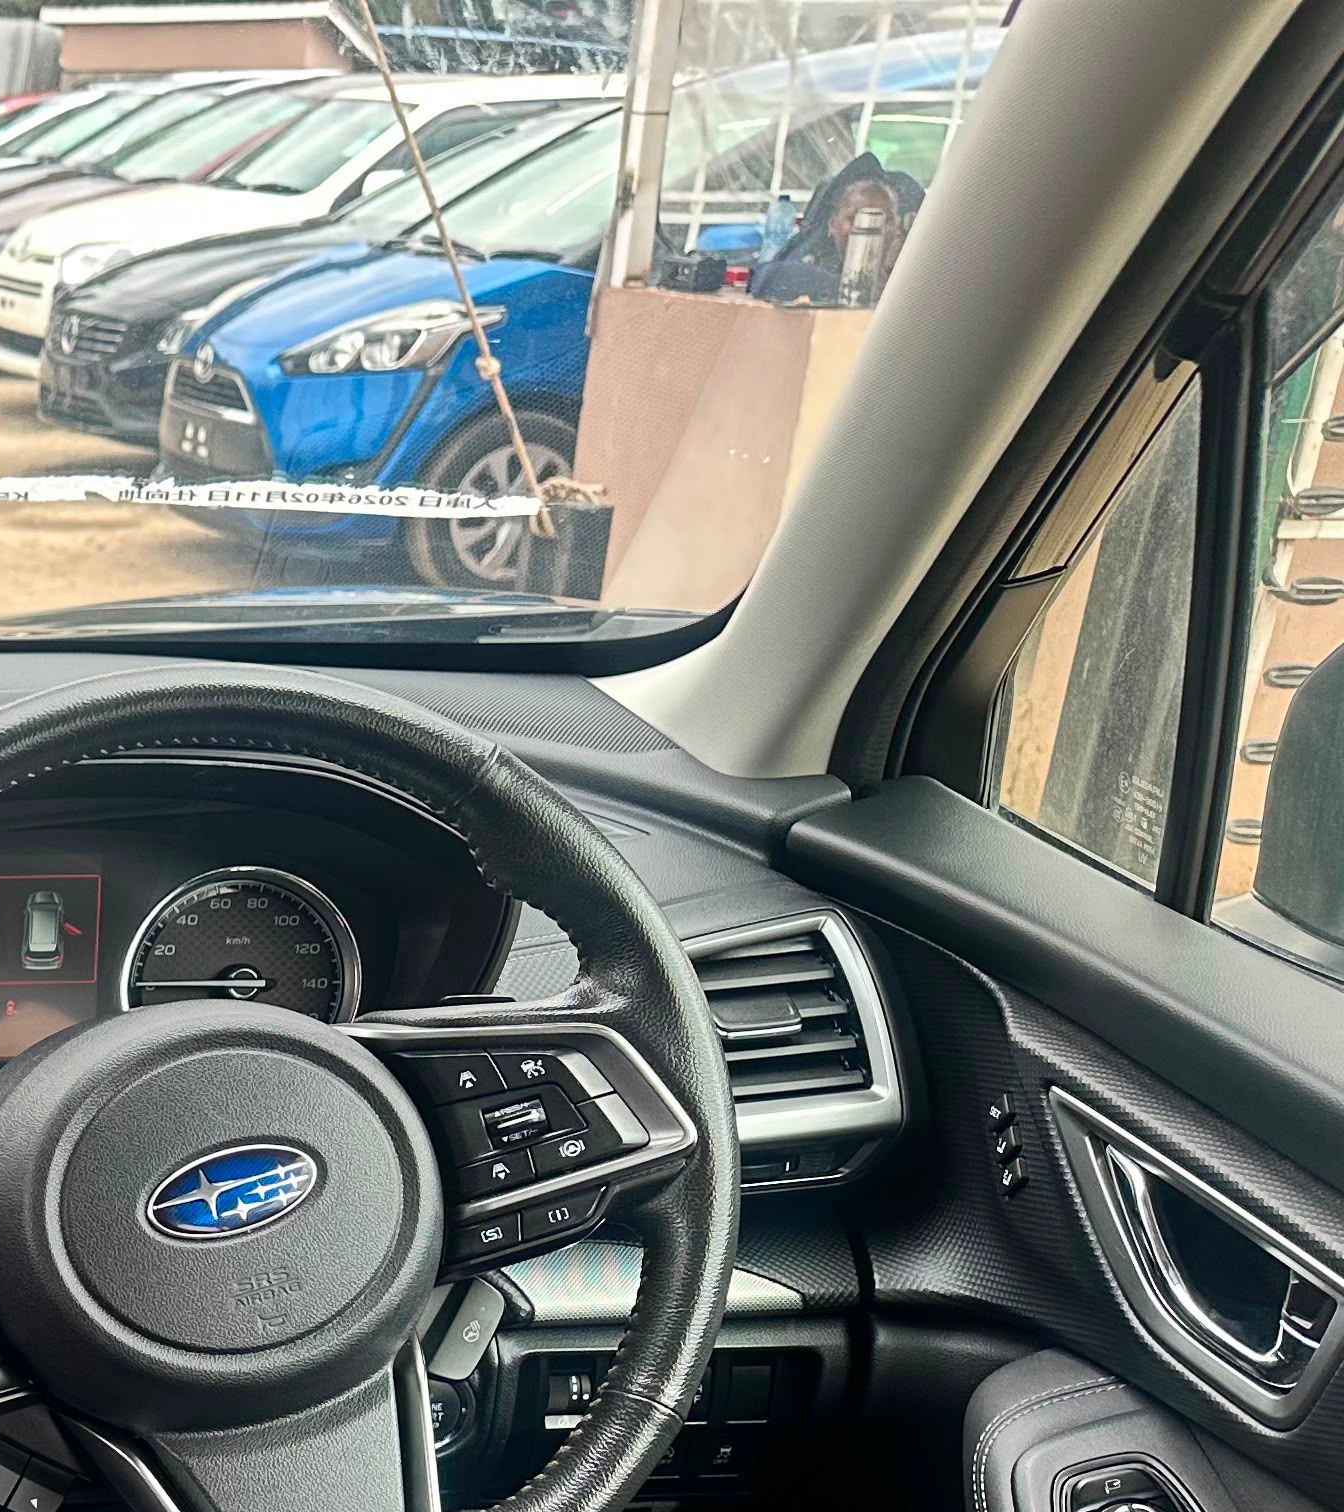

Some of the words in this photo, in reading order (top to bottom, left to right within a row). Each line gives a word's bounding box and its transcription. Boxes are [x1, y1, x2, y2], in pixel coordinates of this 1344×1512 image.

[209, 898, 232, 910] 60
[246, 898, 269, 910] 80
[175, 914, 199, 926] 40
[273, 915, 300, 926] 100
[225, 935, 251, 946] km/h
[154, 944, 176, 956] 20
[295, 943, 320, 955] 120
[301, 978, 328, 989] 140
[232, 1266, 290, 1292] SRS
